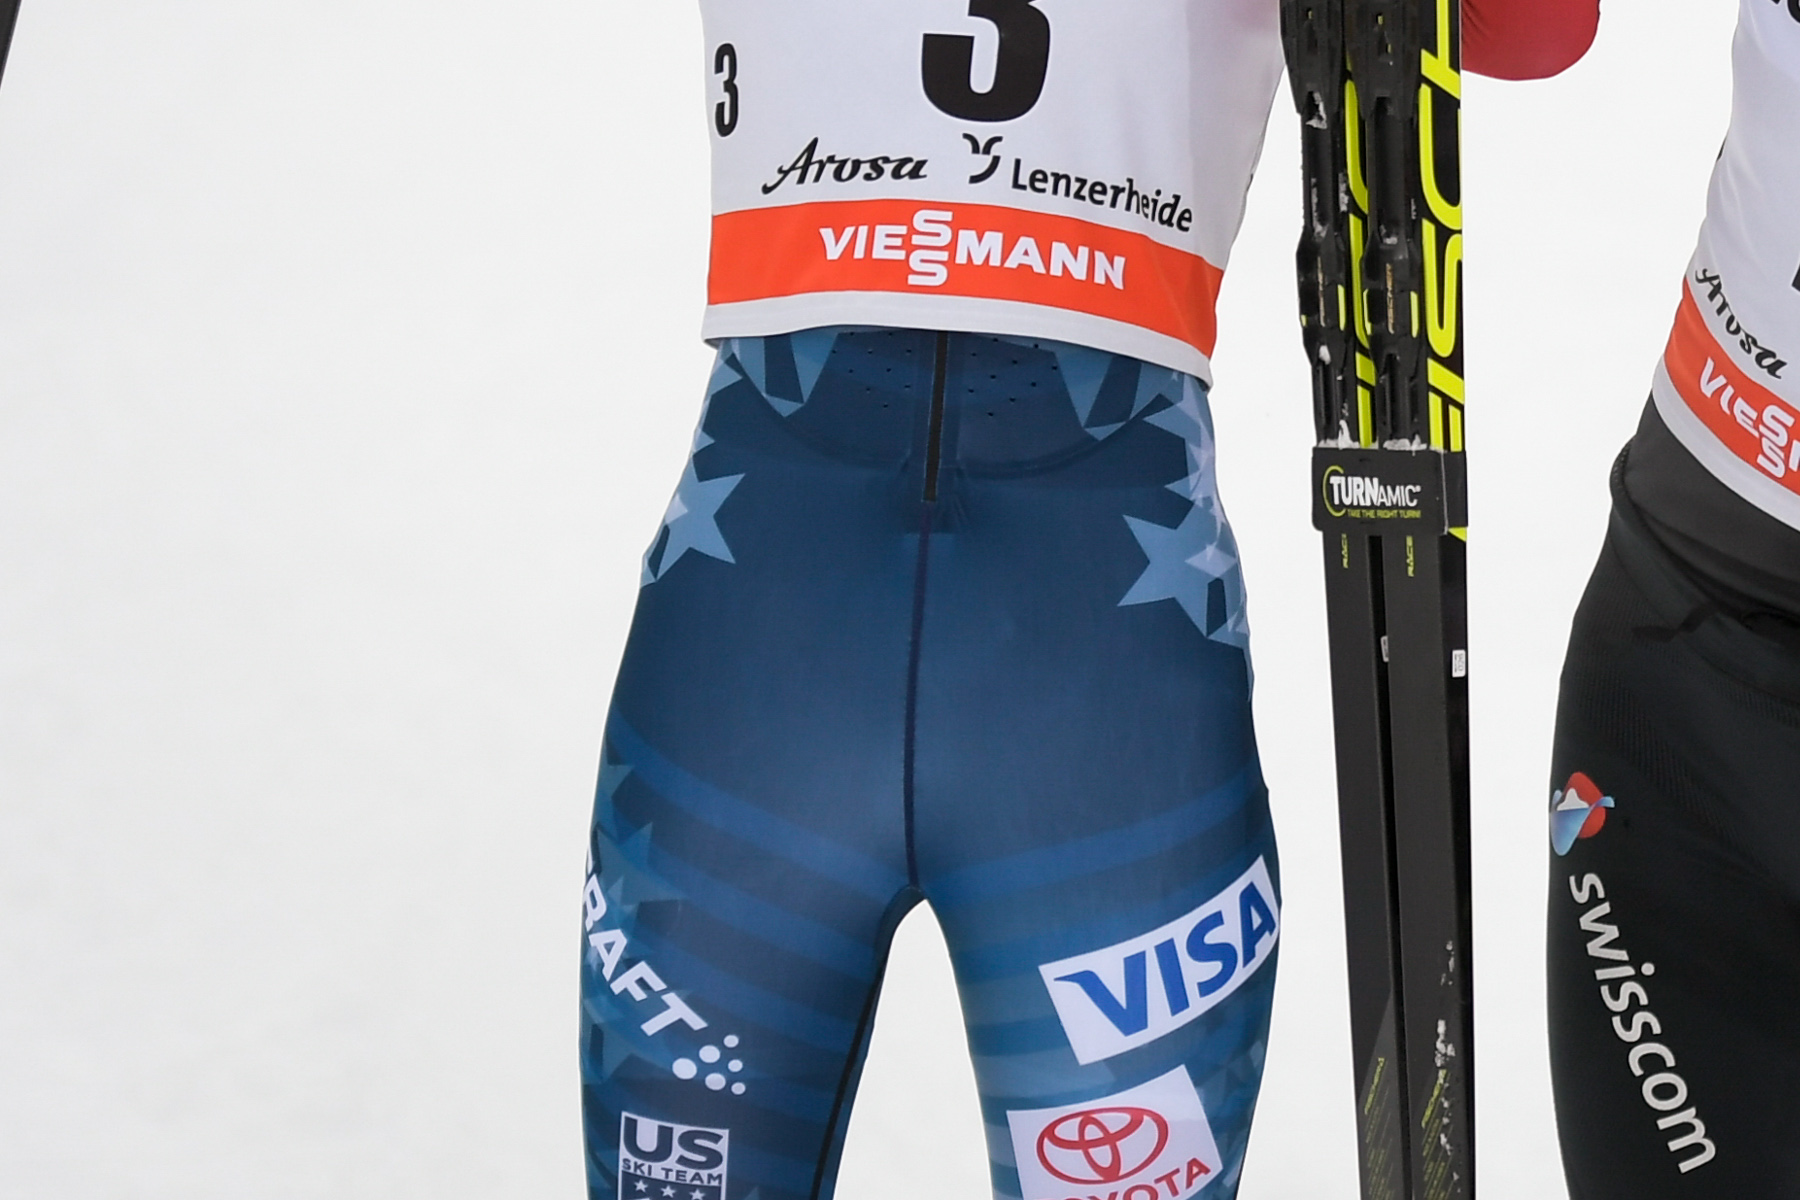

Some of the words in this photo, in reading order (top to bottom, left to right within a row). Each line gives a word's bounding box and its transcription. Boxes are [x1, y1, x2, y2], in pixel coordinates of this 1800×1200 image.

[713, 42, 740, 138] 3
[760, 135, 929, 196] Arosa
[1011, 156, 1193, 234] Lenzerheide
[818, 209, 1126, 291] VIESSMANN
[1694, 265, 1788, 380] Arosa
[1329, 475, 1420, 508] TURNAMIC
[583, 848, 709, 1037] RAFT
[1053, 879, 1278, 1039] VISA
[1568, 872, 1717, 1174] swisscom
[621, 1157, 653, 1177] SKI
[660, 1166, 723, 1185] TEAM
[622, 1115, 724, 1171] US
